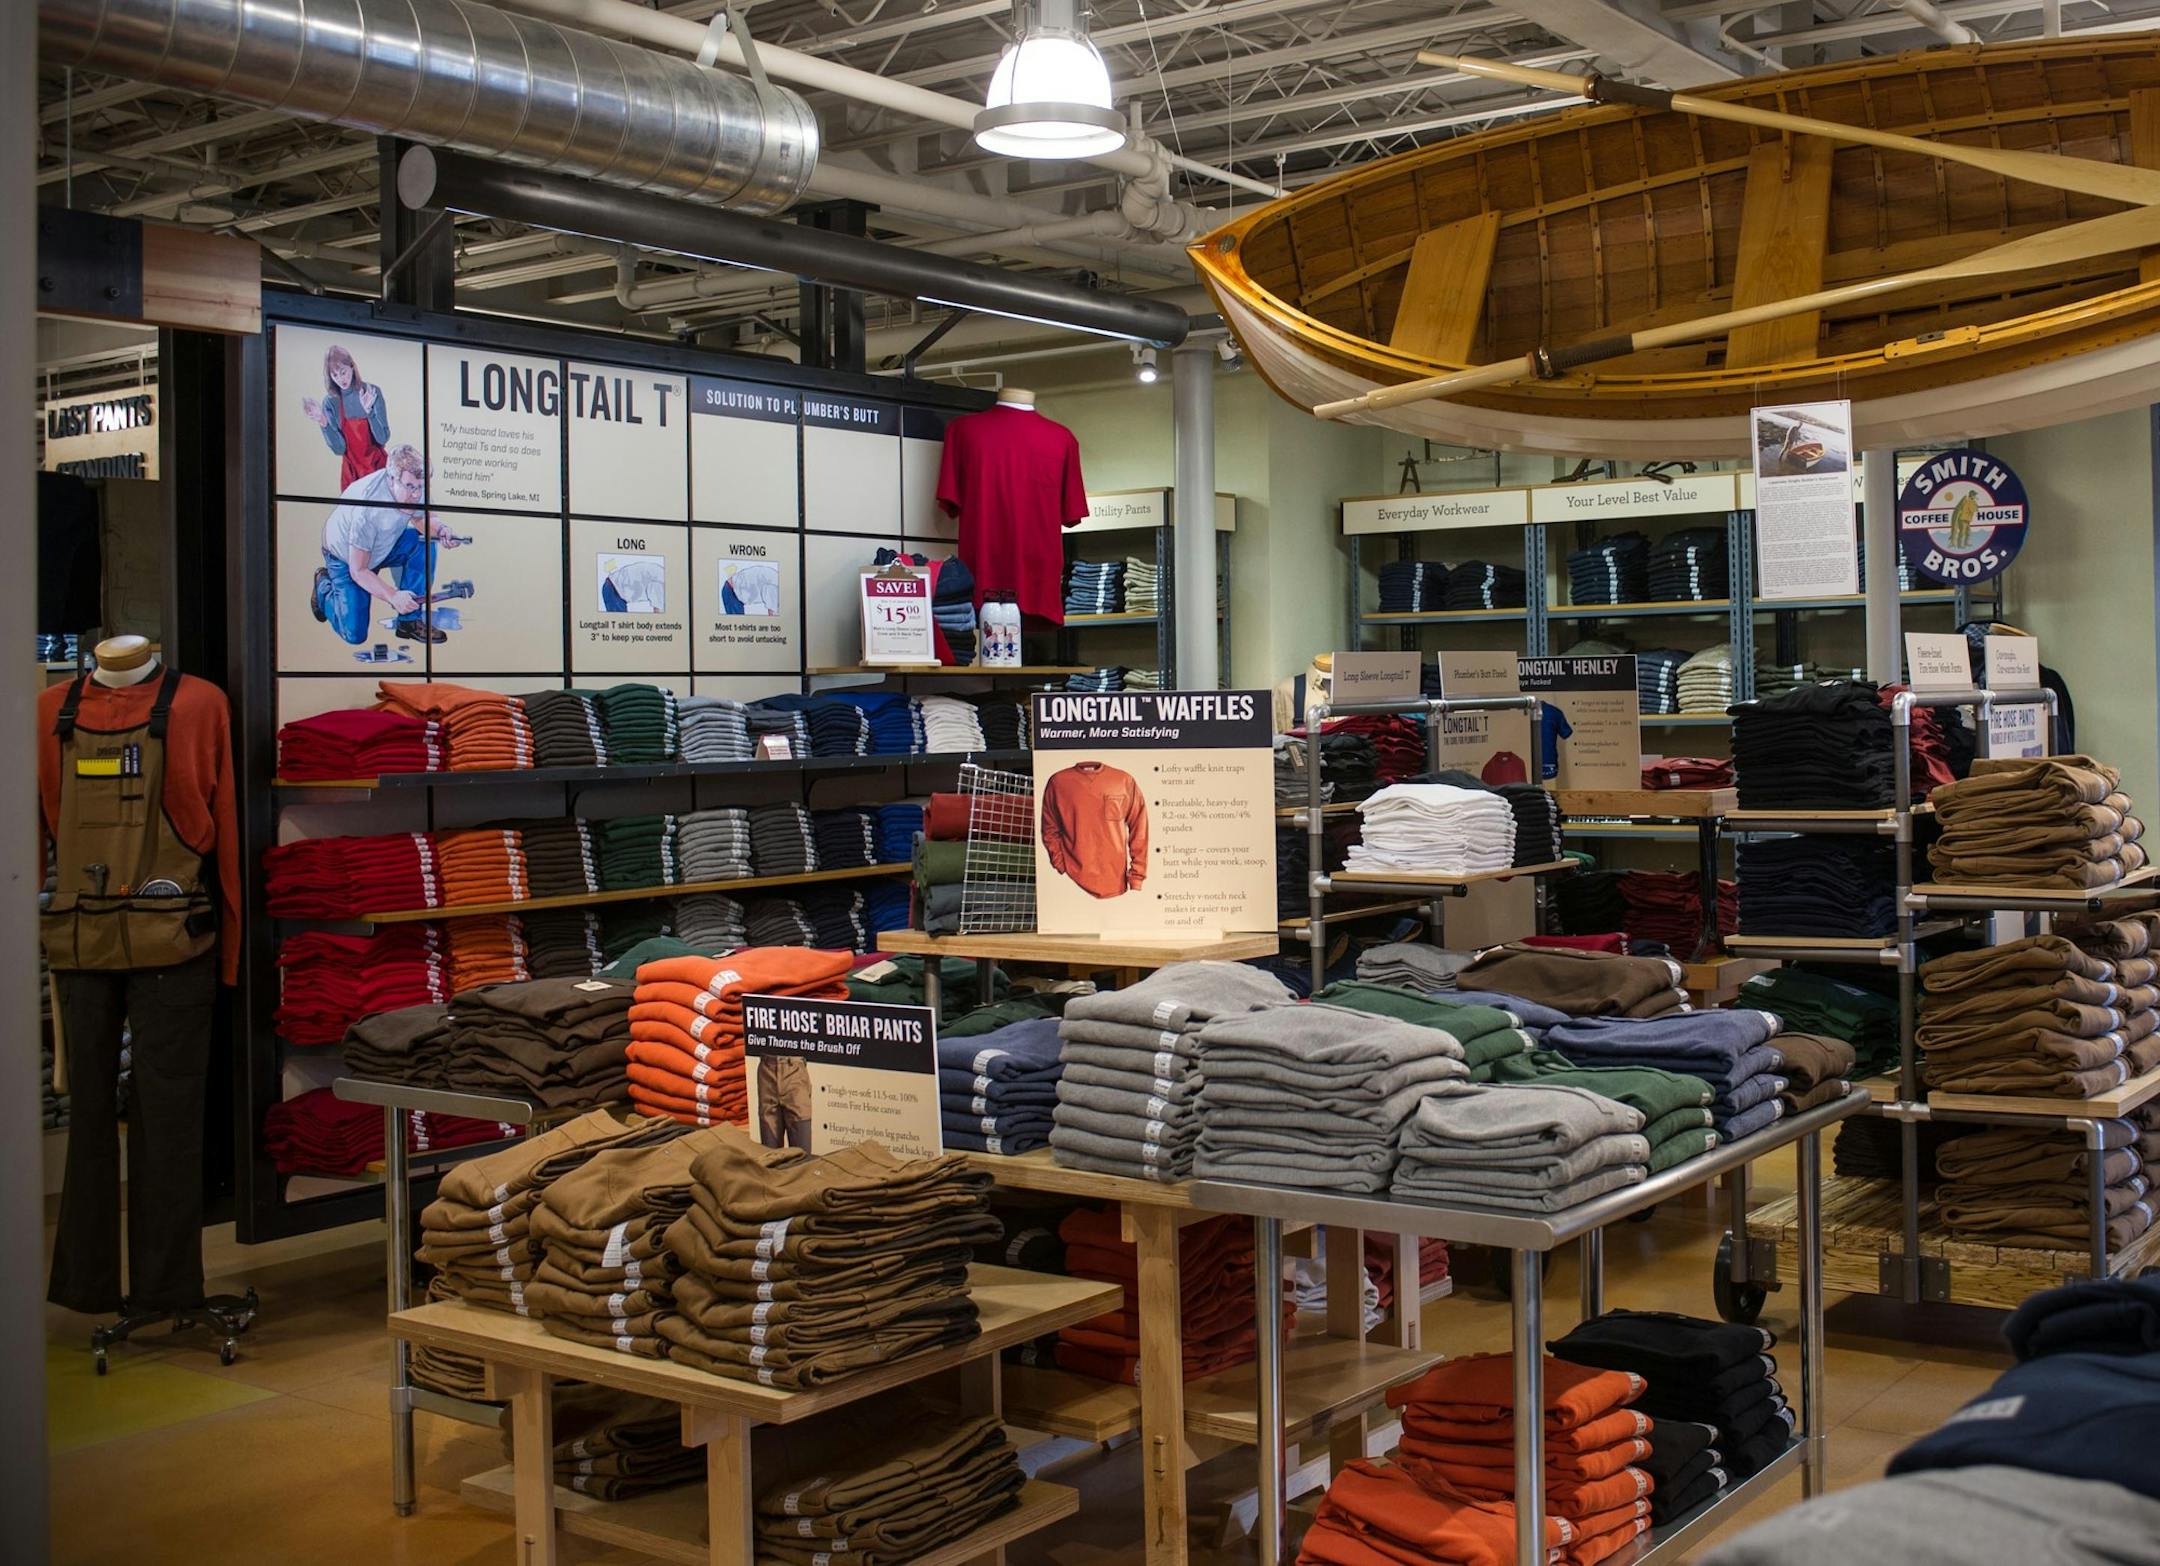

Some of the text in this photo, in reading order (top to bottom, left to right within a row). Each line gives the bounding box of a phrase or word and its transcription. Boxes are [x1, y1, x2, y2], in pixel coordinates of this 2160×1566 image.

[461, 360, 642, 424] LONGTAIL
[706, 389, 879, 424] SOLUTION TO PLUMBER'S BUTT
[48, 394, 152, 439] LAST PANTS
[459, 425, 497, 437] husband
[498, 428, 520, 439] loves
[522, 430, 534, 440] his
[442, 438, 477, 451] Longtail
[480, 442, 489, 451] Ts
[491, 444, 507, 453] and
[521, 446, 541, 456] does
[443, 456, 518, 471] everyone working
[443, 469, 472, 481] behind
[1914, 456, 2008, 495] SMITH
[481, 490, 506, 501] Spring
[529, 493, 540, 502] MI
[1566, 487, 1698, 508] Your Level Best Value
[1094, 504, 1151, 518] Utility Pants
[1378, 503, 1490, 521] Everyday Workwear
[1904, 509, 2020, 525] COFFEE HOUSE
[617, 538, 646, 550] LONG
[729, 544, 766, 557] WRONG
[1922, 549, 2008, 579] BROS.
[876, 581, 917, 593] SAVE!
[579, 620, 682, 630] Longtail T shirt body extends
[715, 623, 732, 631] Most
[734, 623, 757, 632] t-shirts
[770, 624, 781, 632] too
[602, 633, 609, 641] to
[611, 633, 630, 642] keep
[631, 635, 643, 643] you
[645, 633, 673, 642] covered
[709, 635, 726, 643] short
[737, 635, 755, 643] avoid
[756, 635, 787, 645] untucking
[1517, 659, 1618, 676] ONGTAIL™ HENLEY
[1343, 671, 1359, 683] Long
[1360, 670, 1379, 680] Sleeve
[1157, 695, 1254, 721] WAFFLES
[1484, 715, 1488, 731] T
[1040, 726, 1180, 739] Warmer, More Satisfying
[1161, 763, 1245, 774] Lofty waffle knit traps
[1162, 798, 1248, 808] Breathable, heavy-duty
[1189, 811, 1207, 819] 96%
[1162, 824, 1193, 835] spandex
[1172, 845, 1197, 856] longer
[1231, 847, 1249, 855] your
[1163, 858, 1180, 866] butt
[1182, 857, 1203, 866] while
[1204, 859, 1218, 868] you
[1163, 870, 1199, 879] and bend
[1164, 891, 1247, 902] Stretchy v-notch neck
[1164, 904, 1242, 914] makes it easier to get
[1177, 917, 1191, 925] and
[1193, 916, 1205, 925] off
[746, 1006, 777, 1030] FIRE
[825, 1013, 871, 1039] BRIAR
[873, 1018, 923, 1044] PANTS
[747, 1034, 861, 1055] Give Thorns the Brush Off
[900, 1092, 919, 1103] 100%
[827, 1100, 901, 1115] cotton Fire Hose canvas
[829, 1122, 920, 1143] Heavy-duty nylon leg patches
[892, 1144, 904, 1153] and
[905, 1145, 921, 1155] back
[922, 1146, 934, 1158] legs
